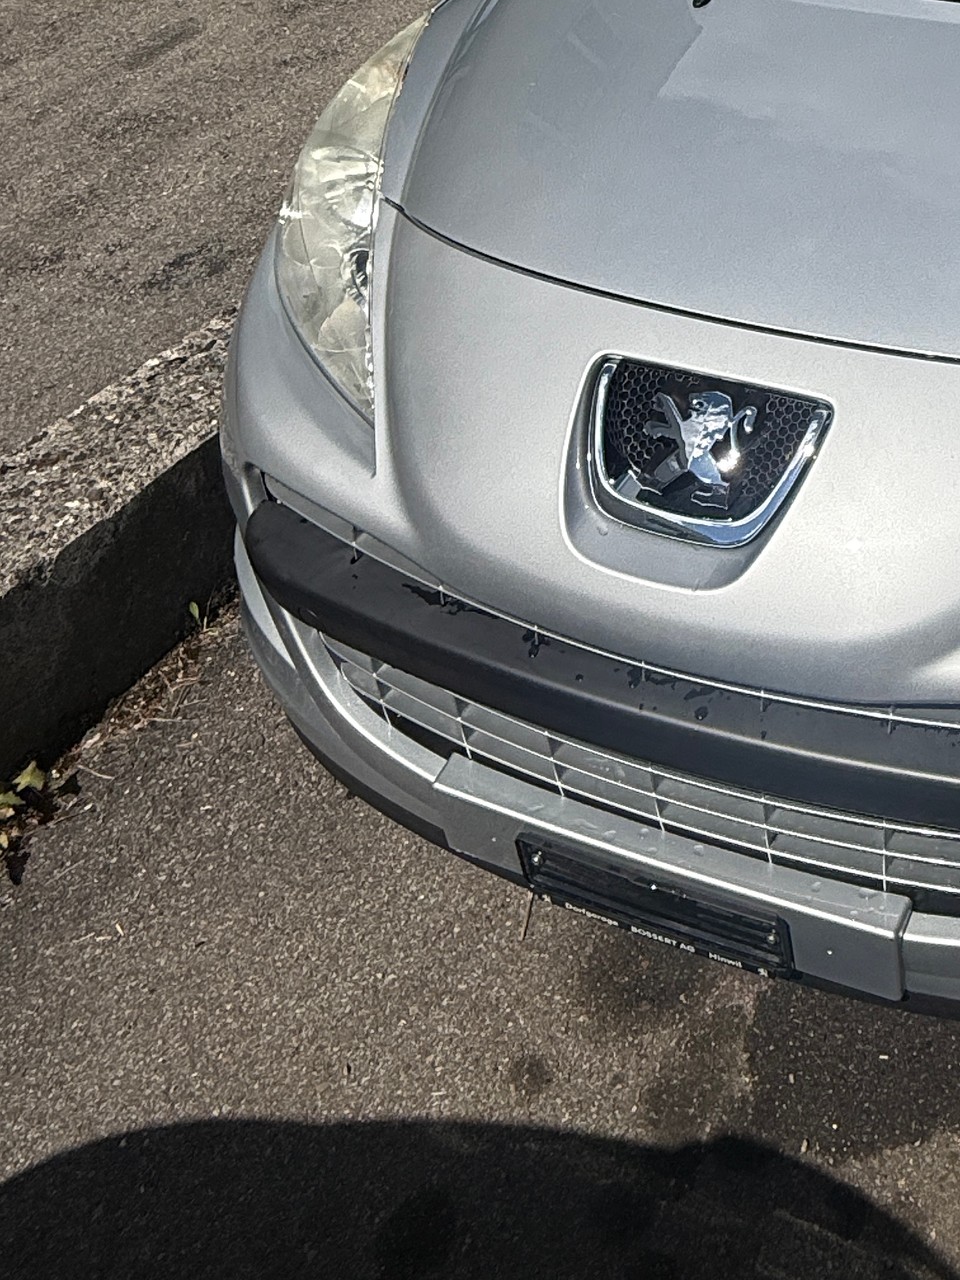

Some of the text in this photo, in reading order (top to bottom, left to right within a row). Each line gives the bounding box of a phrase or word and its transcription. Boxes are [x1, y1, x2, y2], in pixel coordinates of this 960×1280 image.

[630, 925, 677, 946] BOSSERT
[680, 942, 696, 953] AG
[708, 951, 743, 968] Hinwil
